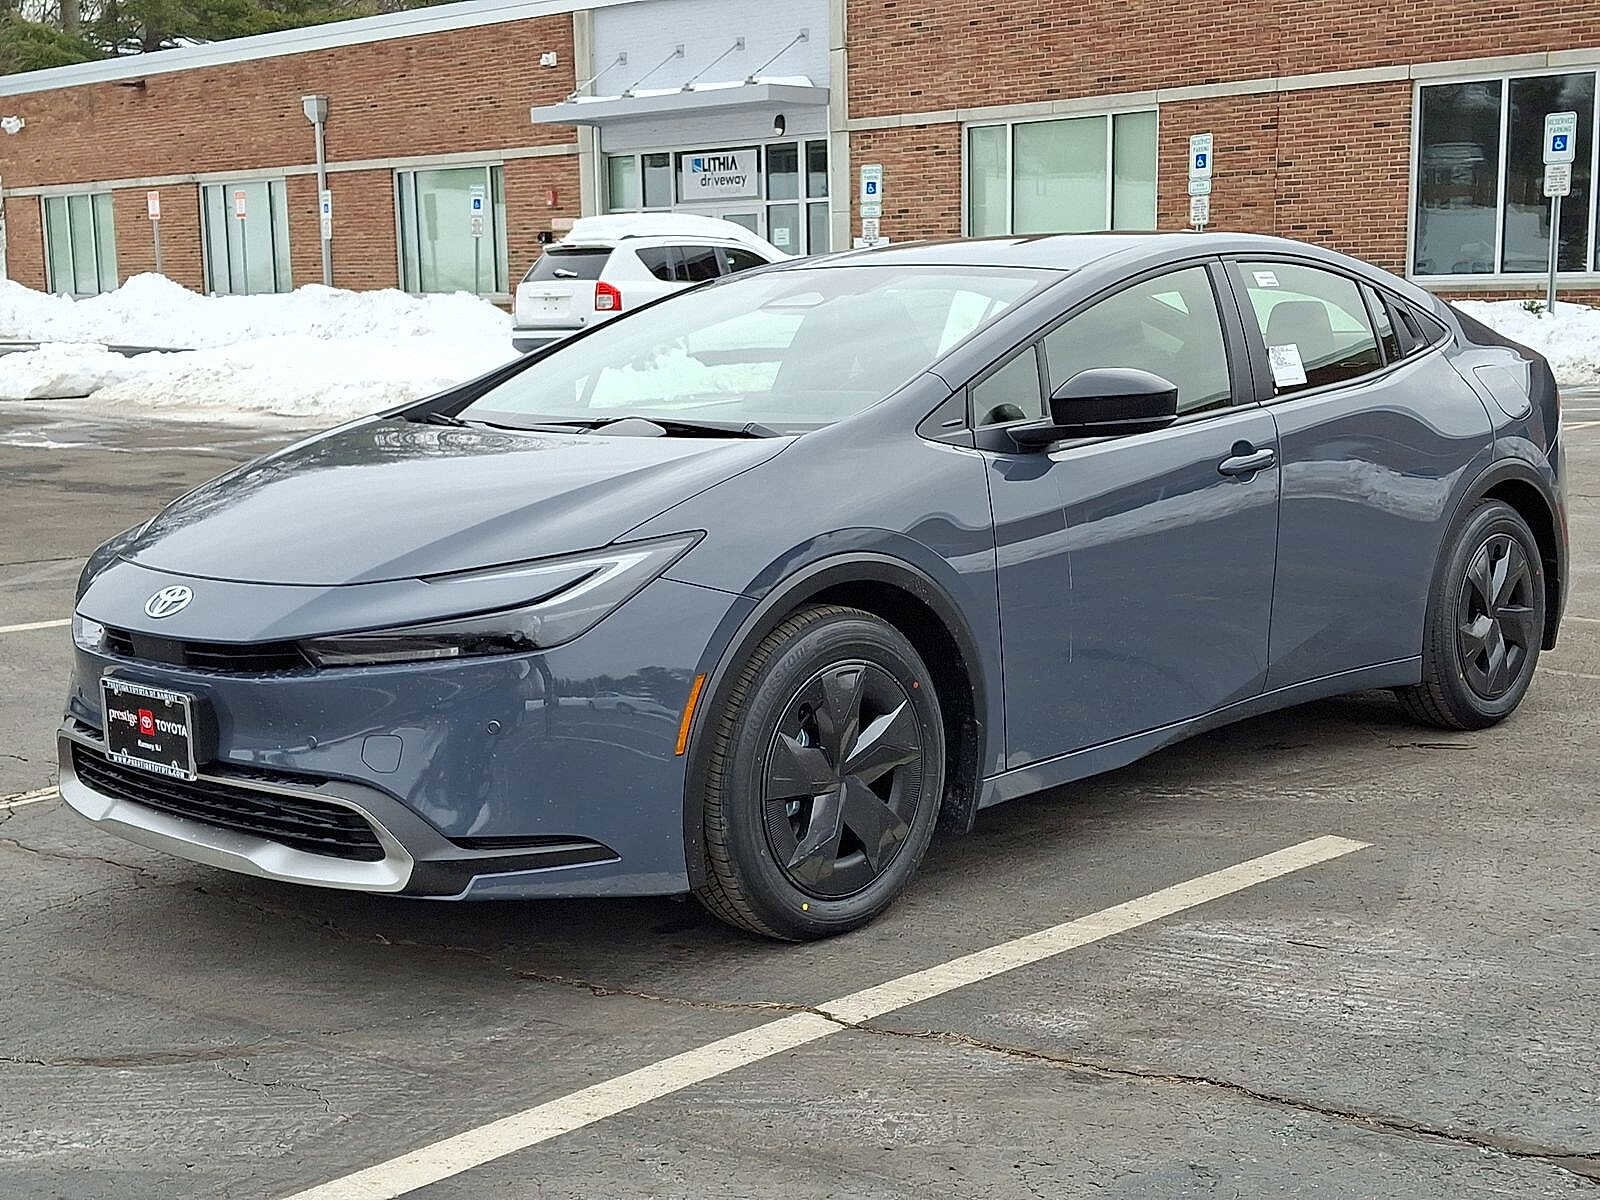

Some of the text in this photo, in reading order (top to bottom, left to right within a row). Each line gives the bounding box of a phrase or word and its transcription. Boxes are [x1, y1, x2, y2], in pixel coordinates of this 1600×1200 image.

[702, 155, 738, 172] LITHIA
[700, 172, 747, 188] driveway
[108, 708, 188, 738] prestige TOYOTA
